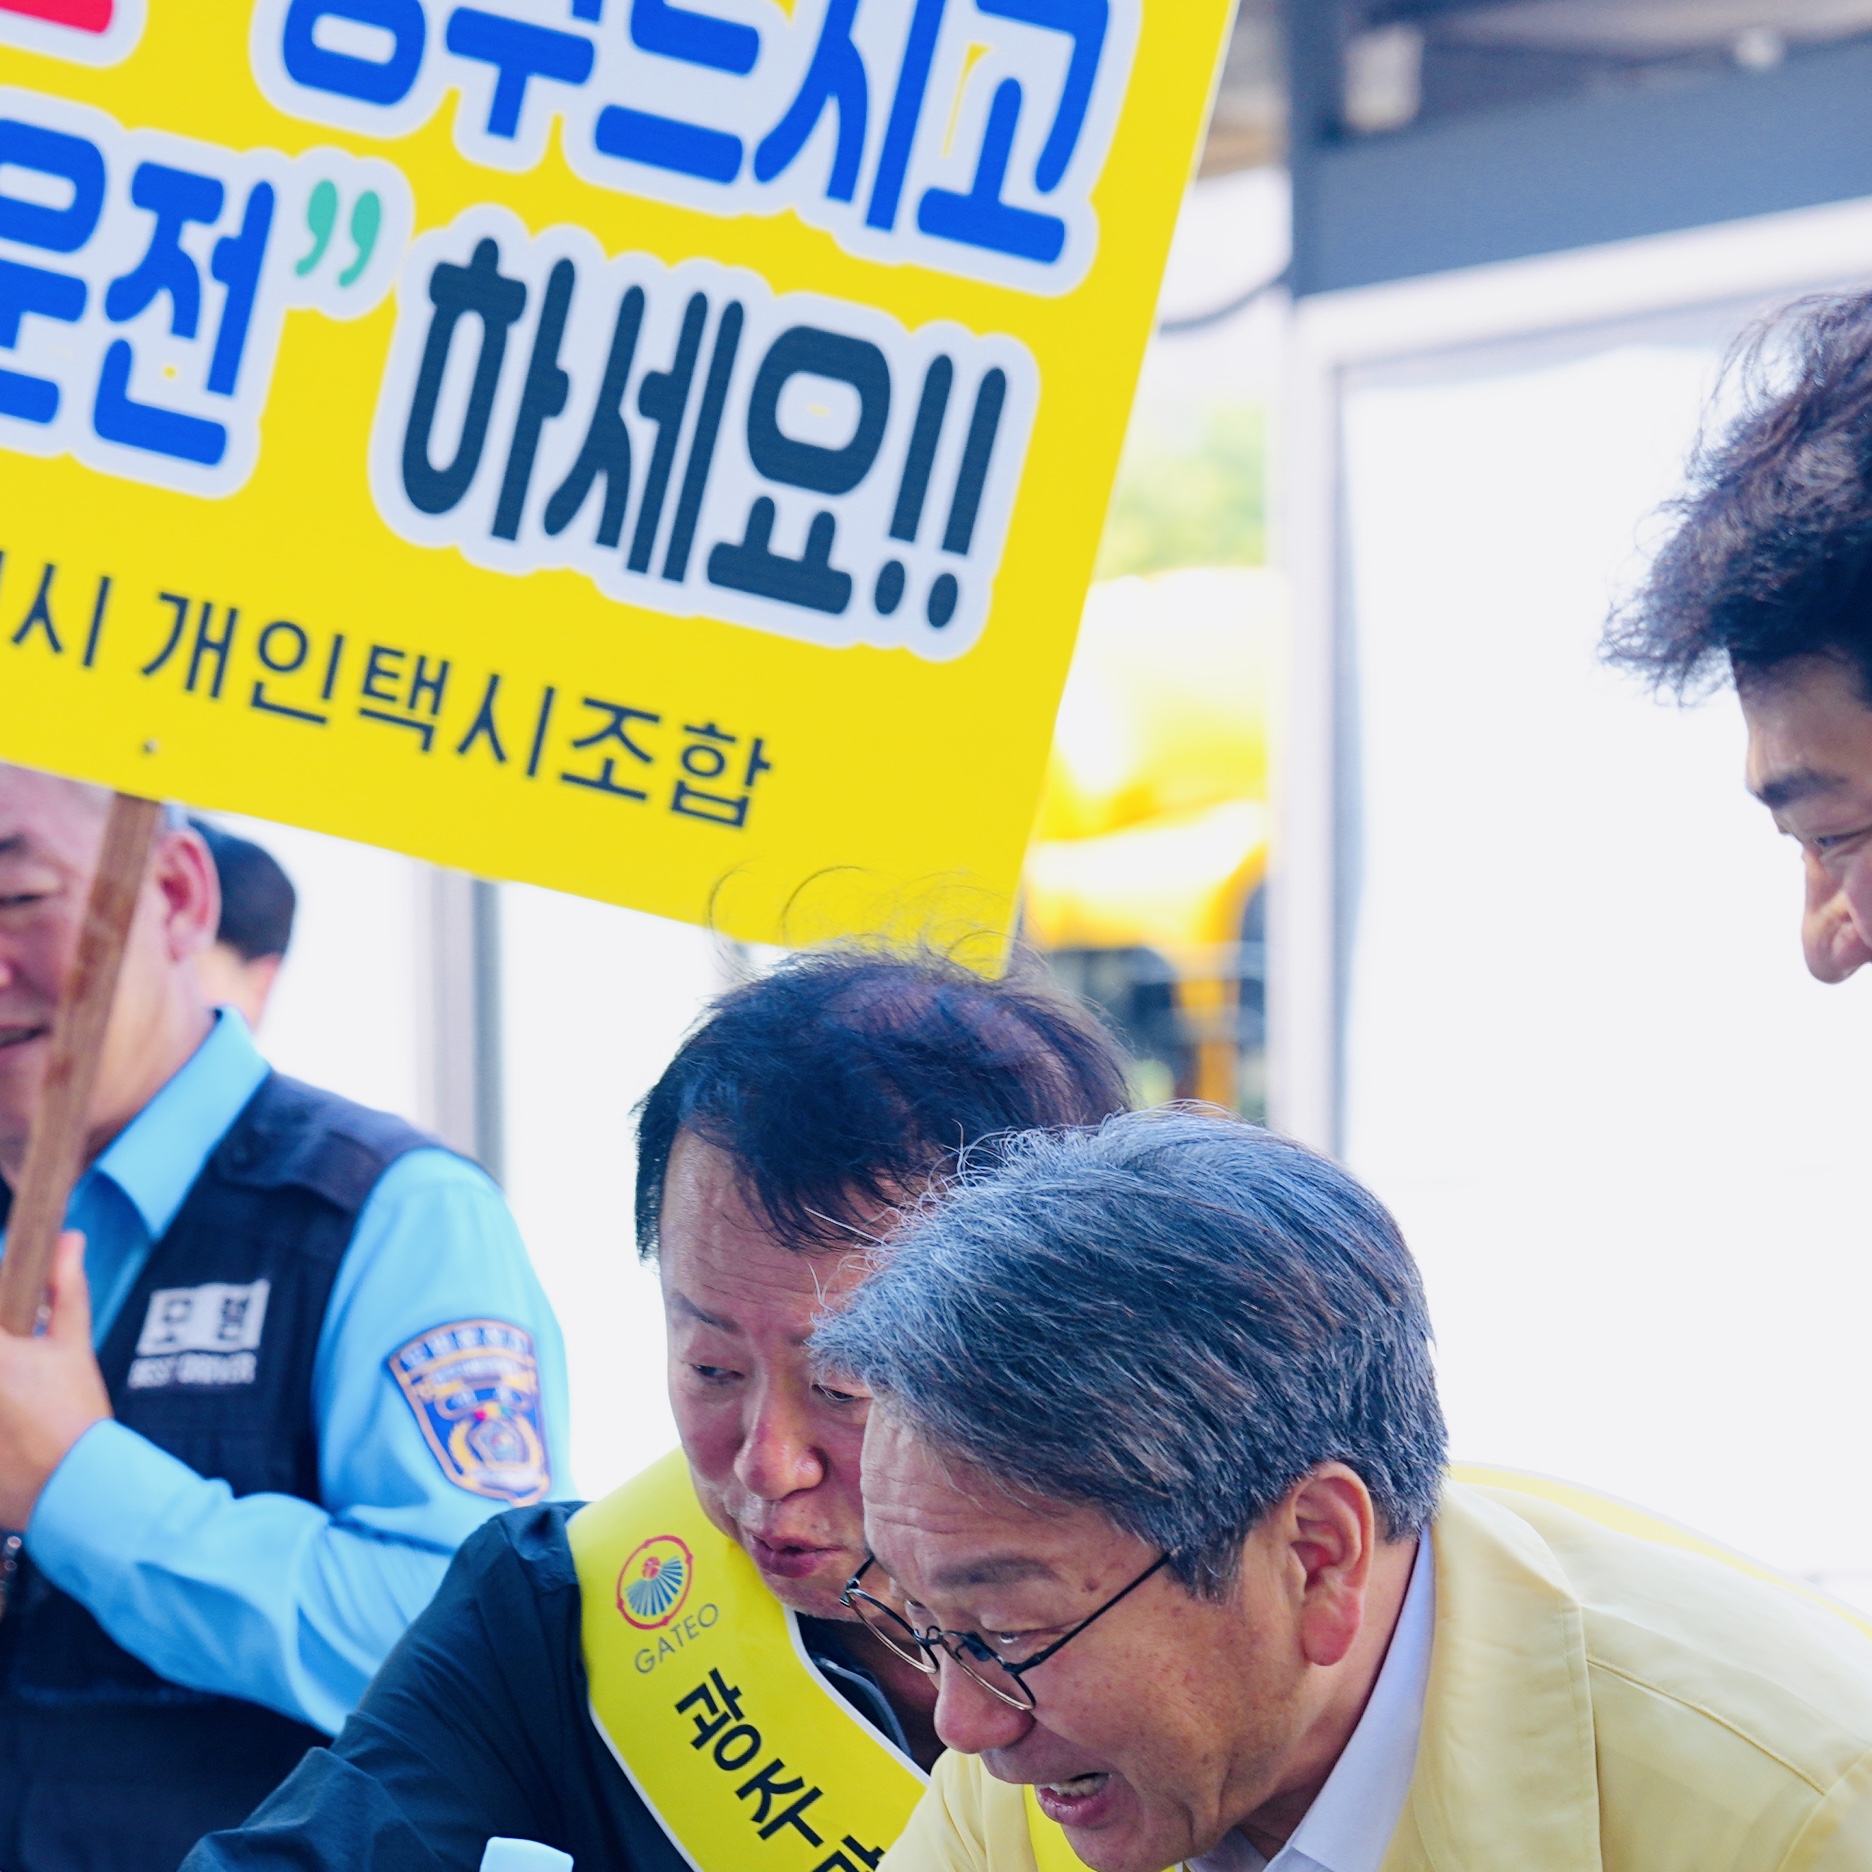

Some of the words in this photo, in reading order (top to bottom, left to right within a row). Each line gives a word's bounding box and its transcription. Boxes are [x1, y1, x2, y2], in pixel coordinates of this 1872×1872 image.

[400, 236, 1008, 630] 하세요!!
[140, 590, 775, 830] 개인택시조합
[635, 1602, 720, 1674] GATEO
